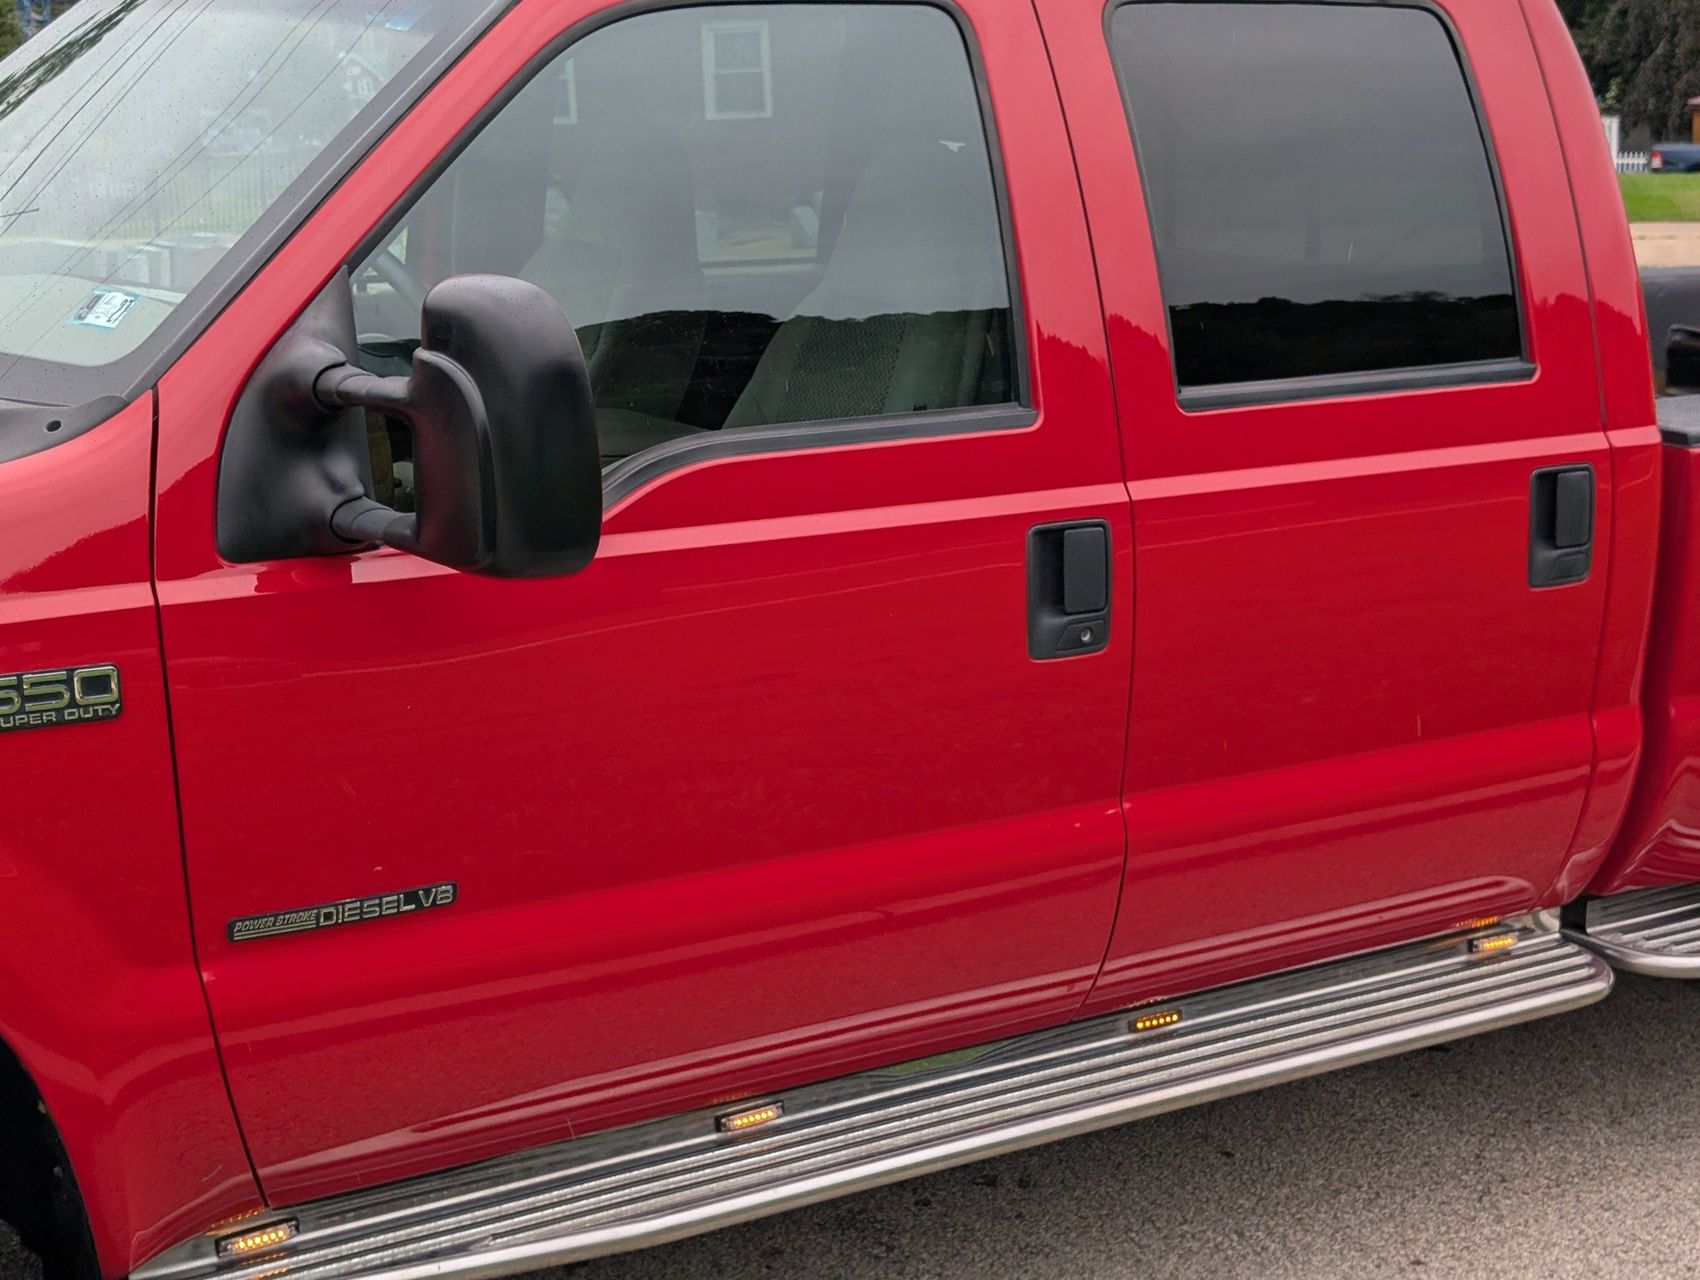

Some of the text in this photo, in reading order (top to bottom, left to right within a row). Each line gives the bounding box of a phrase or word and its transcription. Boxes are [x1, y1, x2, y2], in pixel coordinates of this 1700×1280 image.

[64, 703, 120, 720] DUTY
[233, 885, 453, 933] POWER STROKE DIESEL V8
